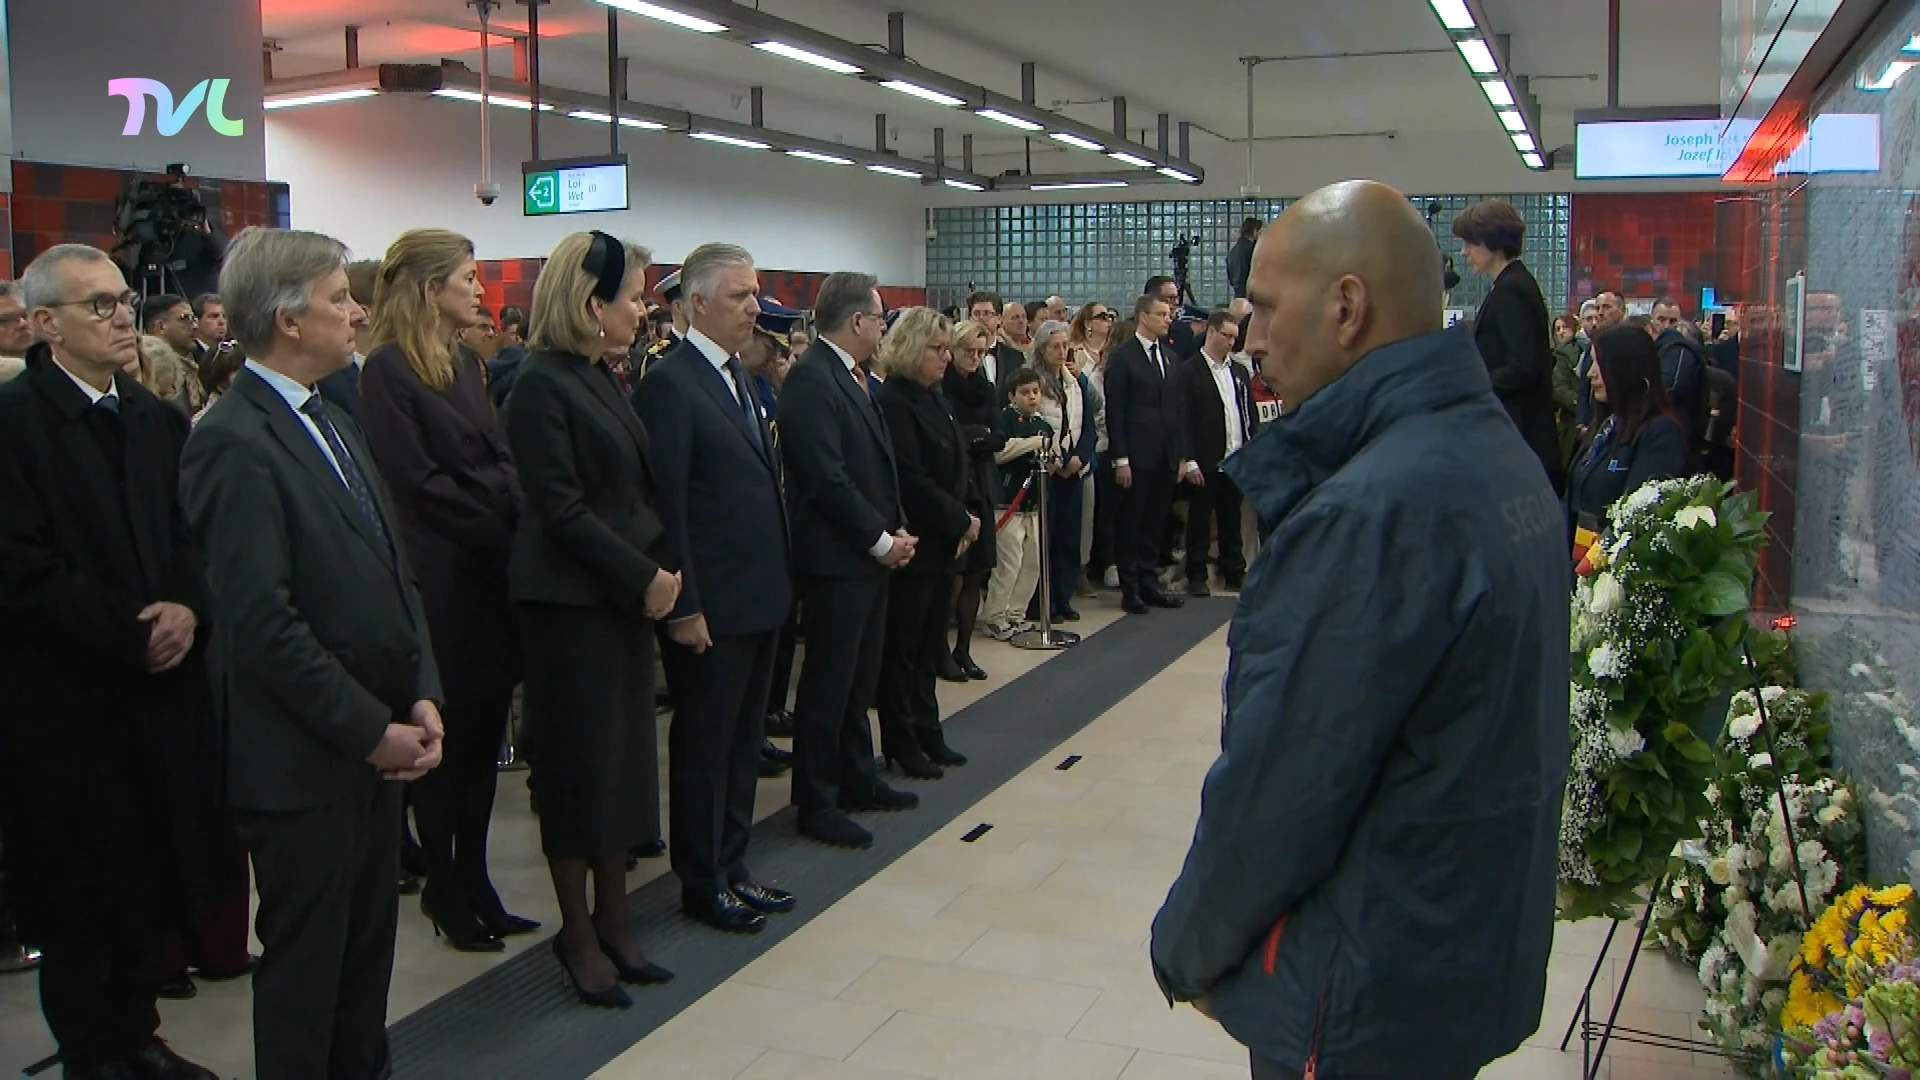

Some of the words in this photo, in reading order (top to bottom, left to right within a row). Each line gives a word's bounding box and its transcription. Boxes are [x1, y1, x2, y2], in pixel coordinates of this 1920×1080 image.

[1664, 133, 1713, 148] Joseph
[1677, 148, 1714, 162] Jozef
[568, 179, 581, 189] Loi
[543, 187, 549, 196] 2
[568, 191, 584, 201] Wet
